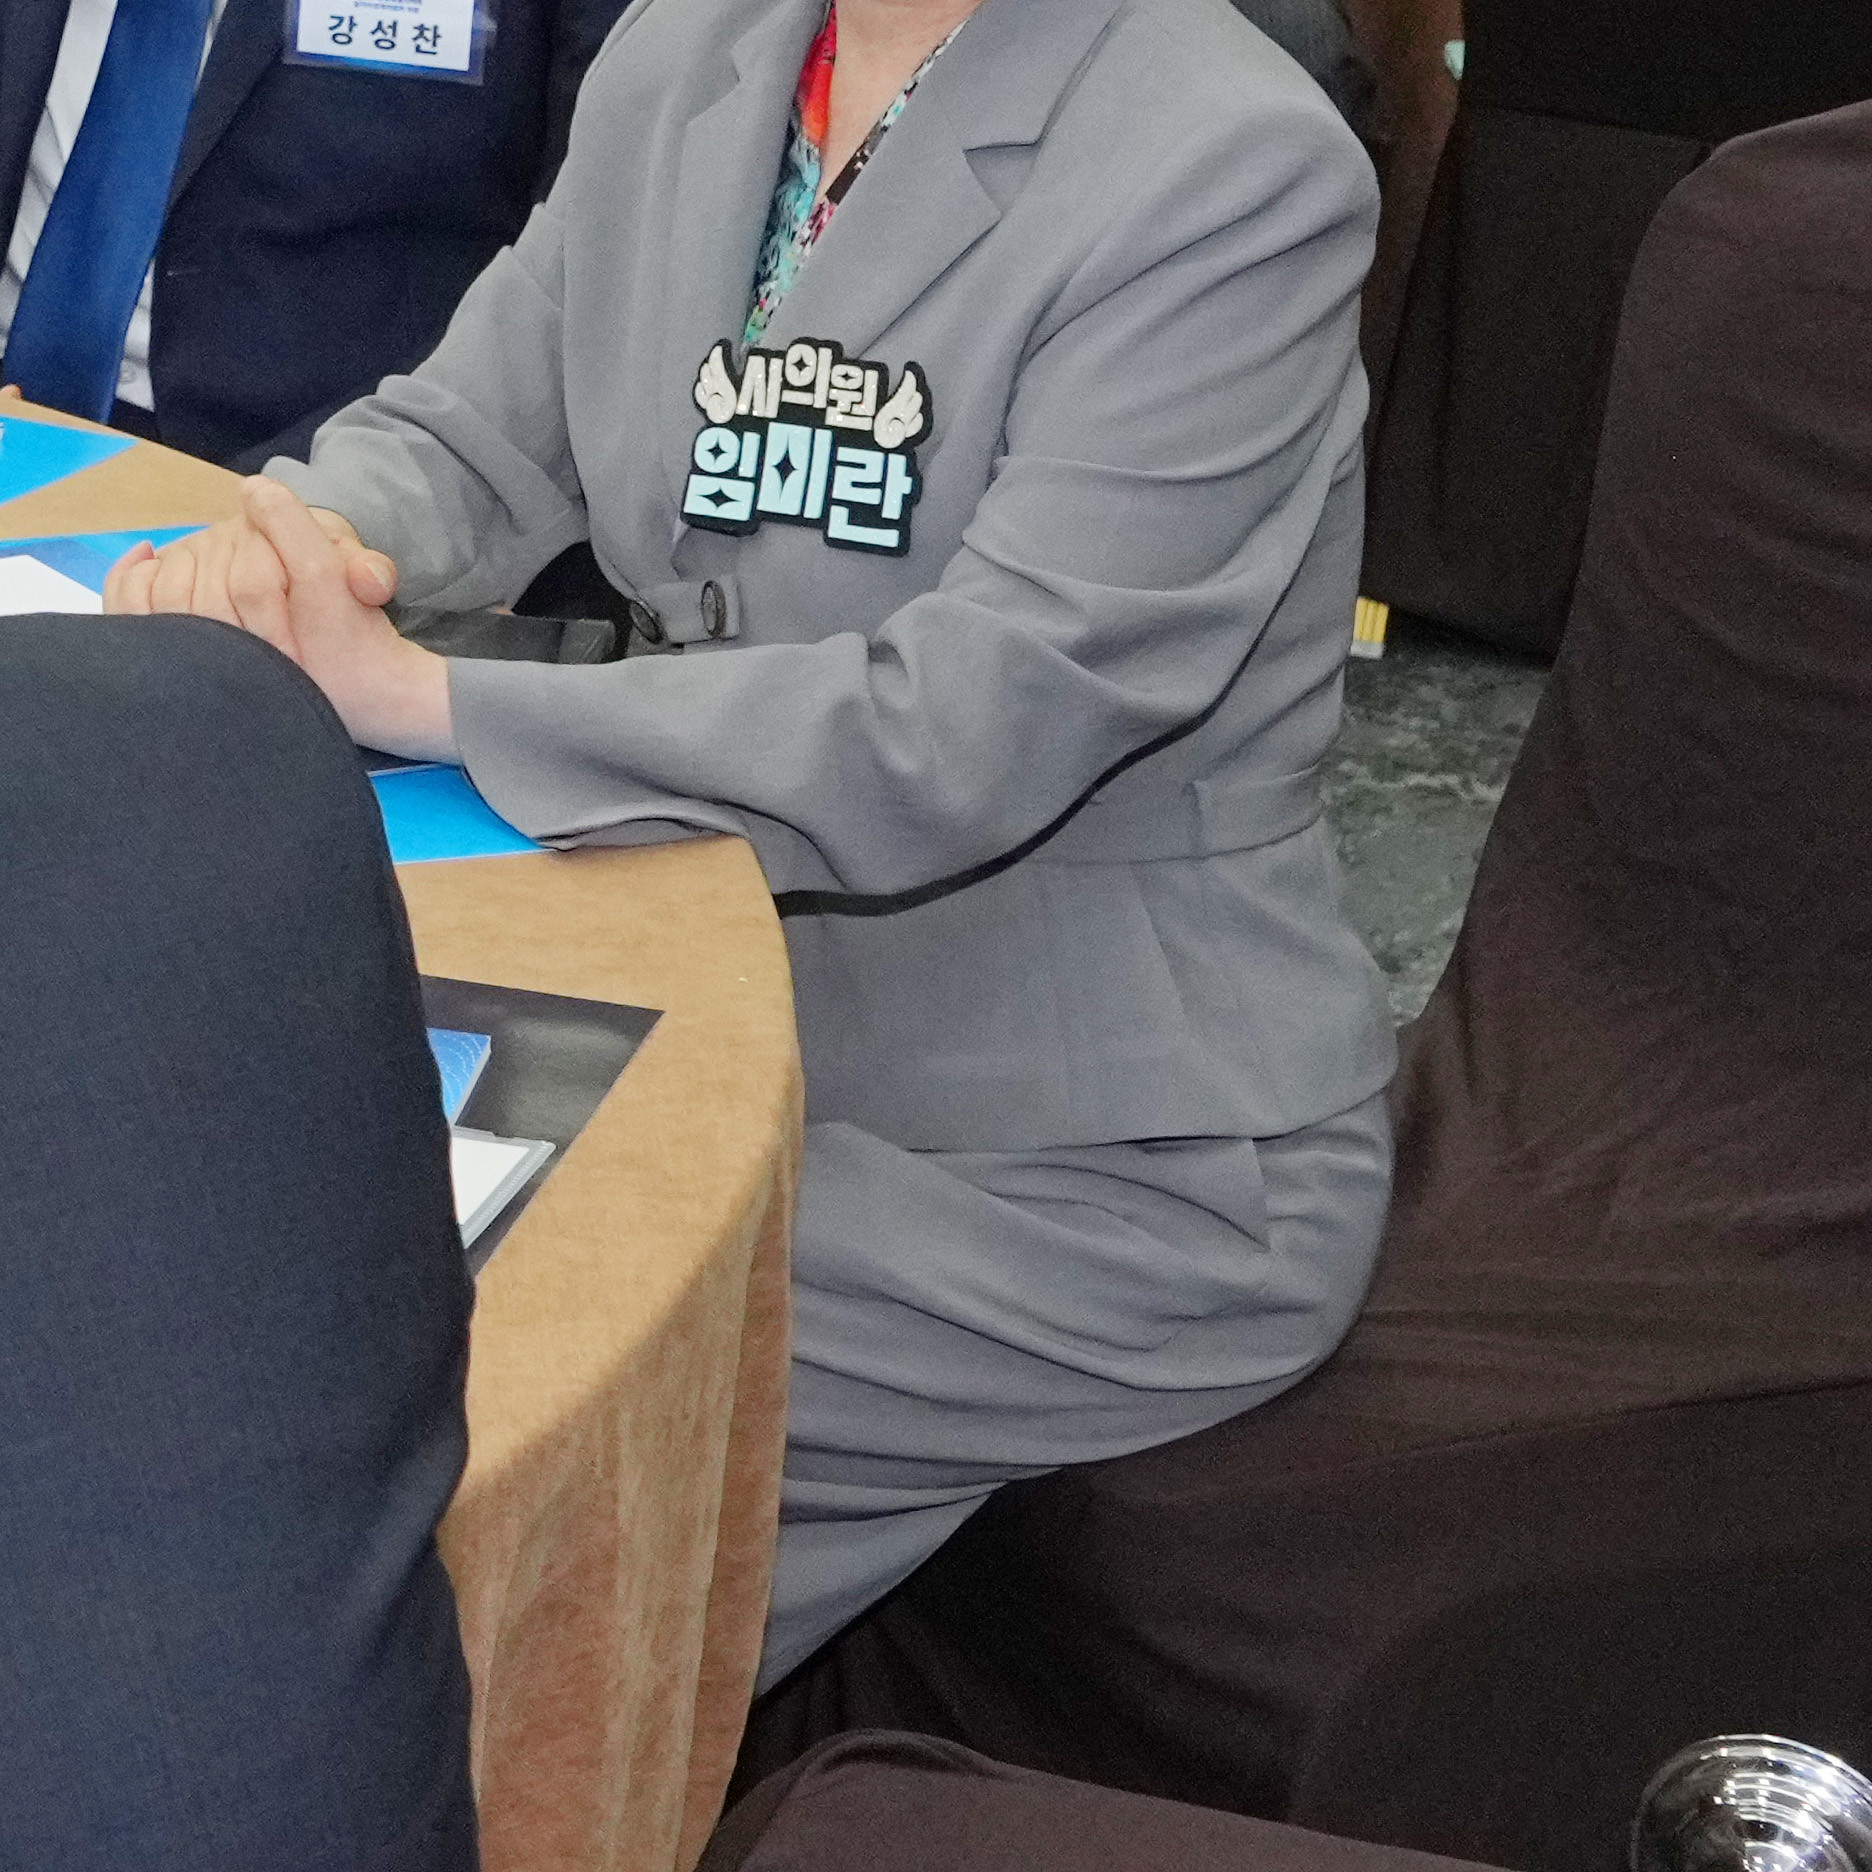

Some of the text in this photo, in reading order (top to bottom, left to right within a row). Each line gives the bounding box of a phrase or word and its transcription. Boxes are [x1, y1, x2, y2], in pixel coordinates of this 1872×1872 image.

[328, 15, 444, 56] 강 성 찬
[737, 343, 879, 430] 시의원
[683, 422, 913, 548] 임미란
